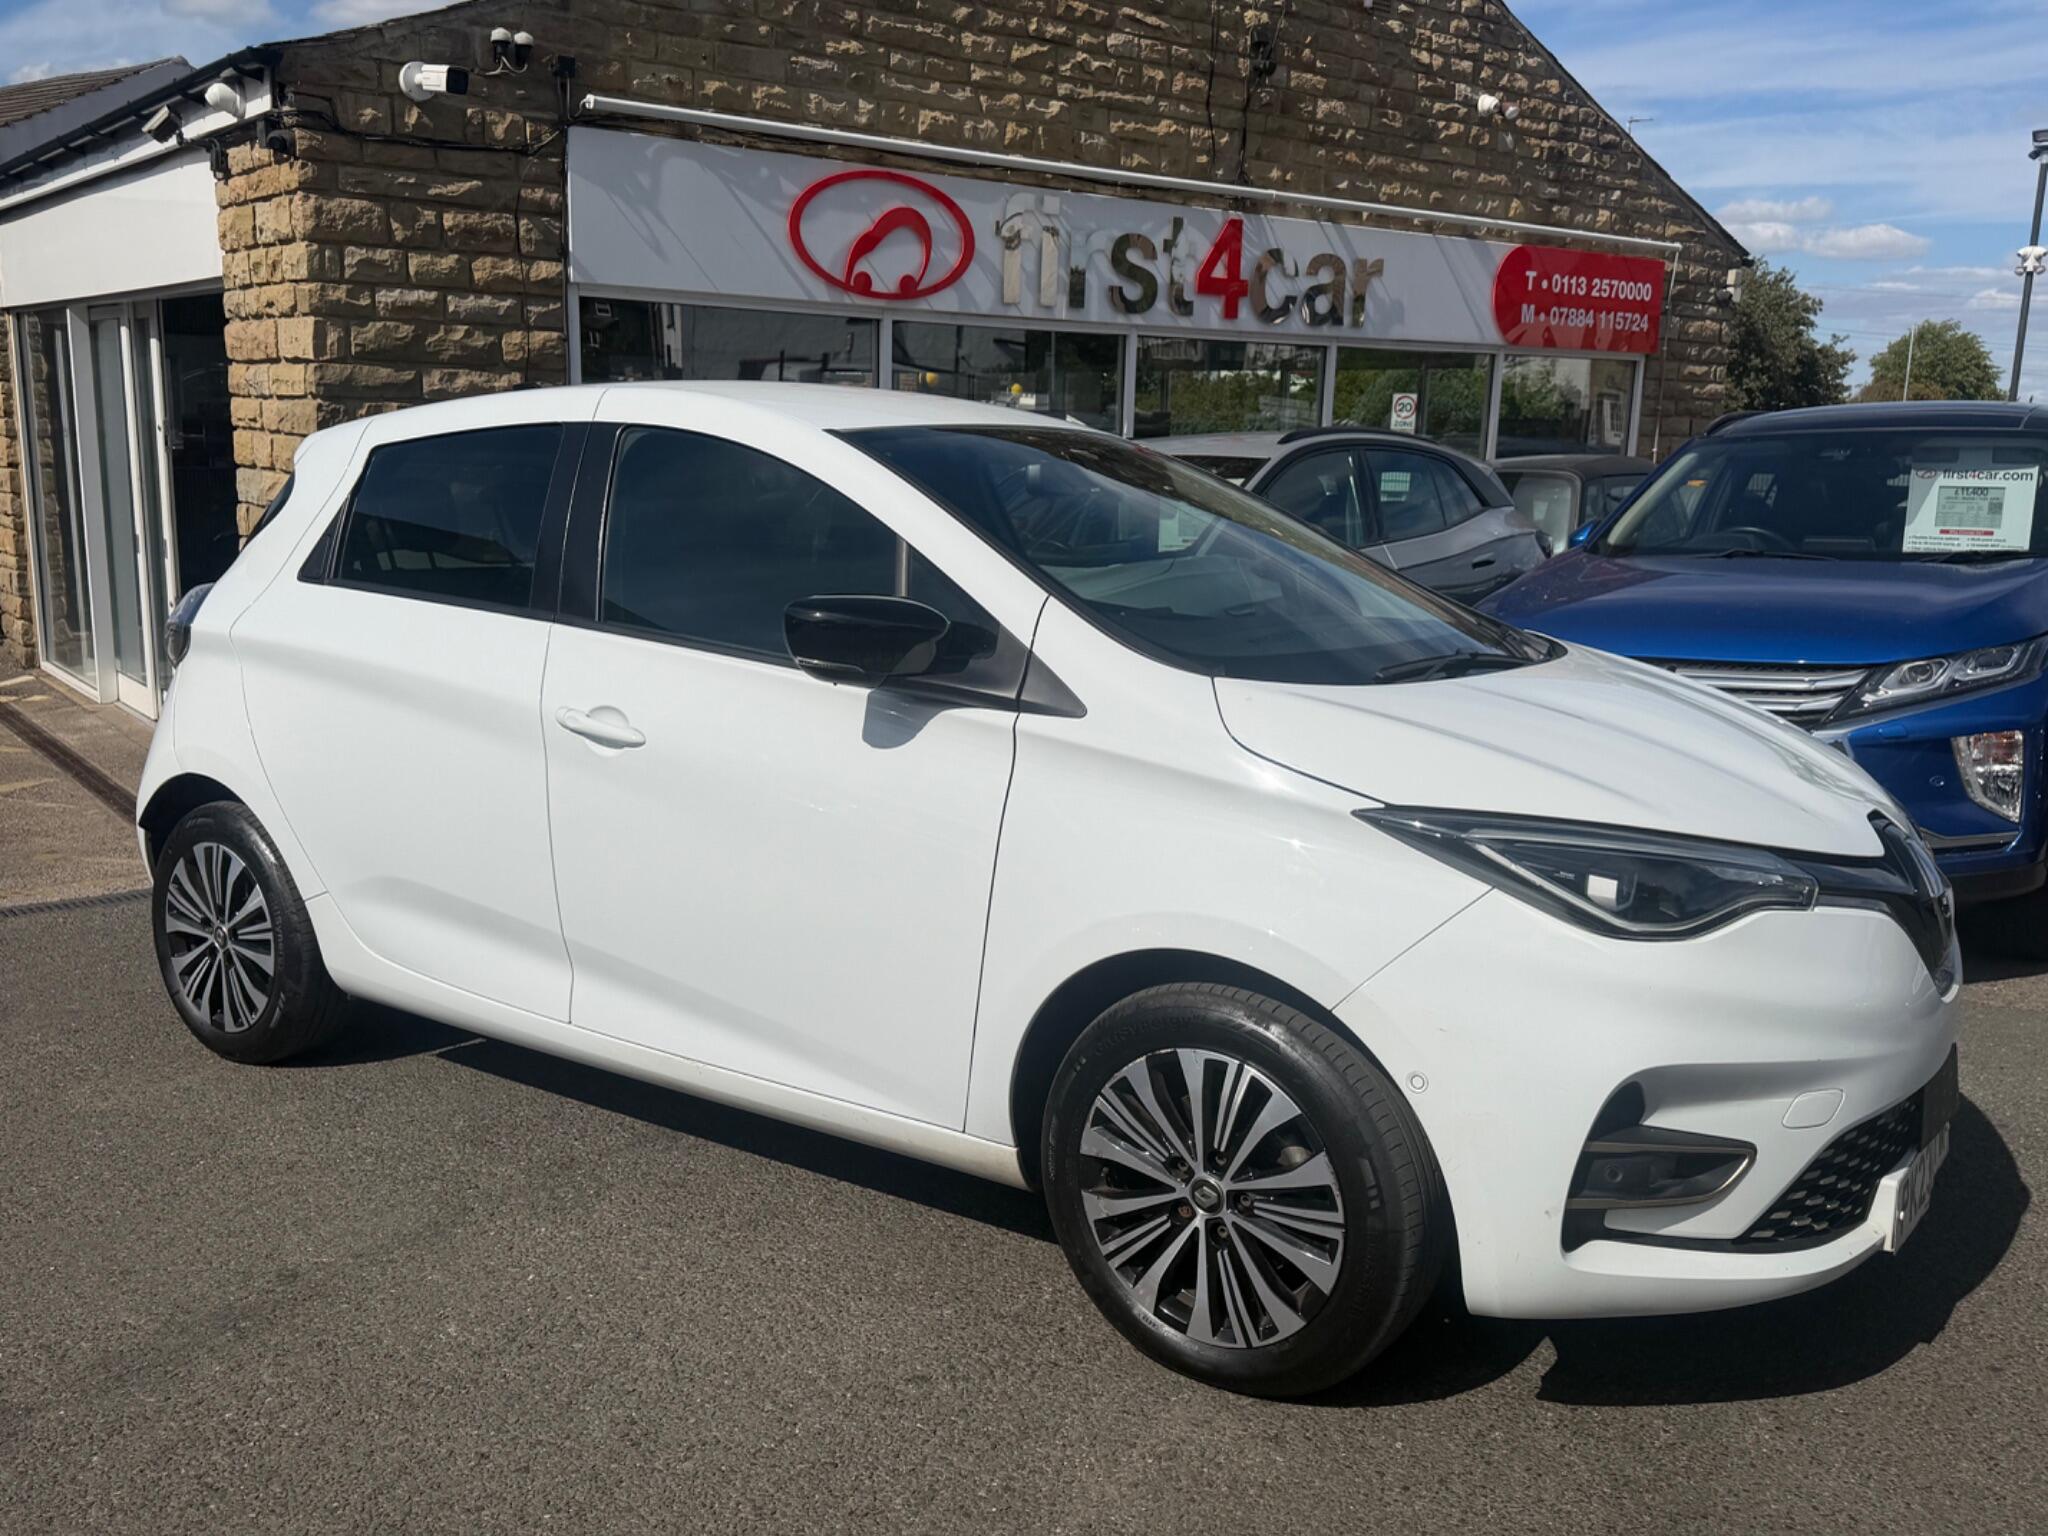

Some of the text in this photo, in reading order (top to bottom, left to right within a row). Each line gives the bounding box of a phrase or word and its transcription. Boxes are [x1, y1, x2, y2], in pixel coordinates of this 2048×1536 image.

[996, 192, 1384, 329] first4car
[1525, 270, 1652, 301] T 0113 2570000
[1520, 304, 1649, 332] M 07884 115724
[1397, 402, 1412, 413] 20
[1943, 469, 2034, 481] first4car.com
